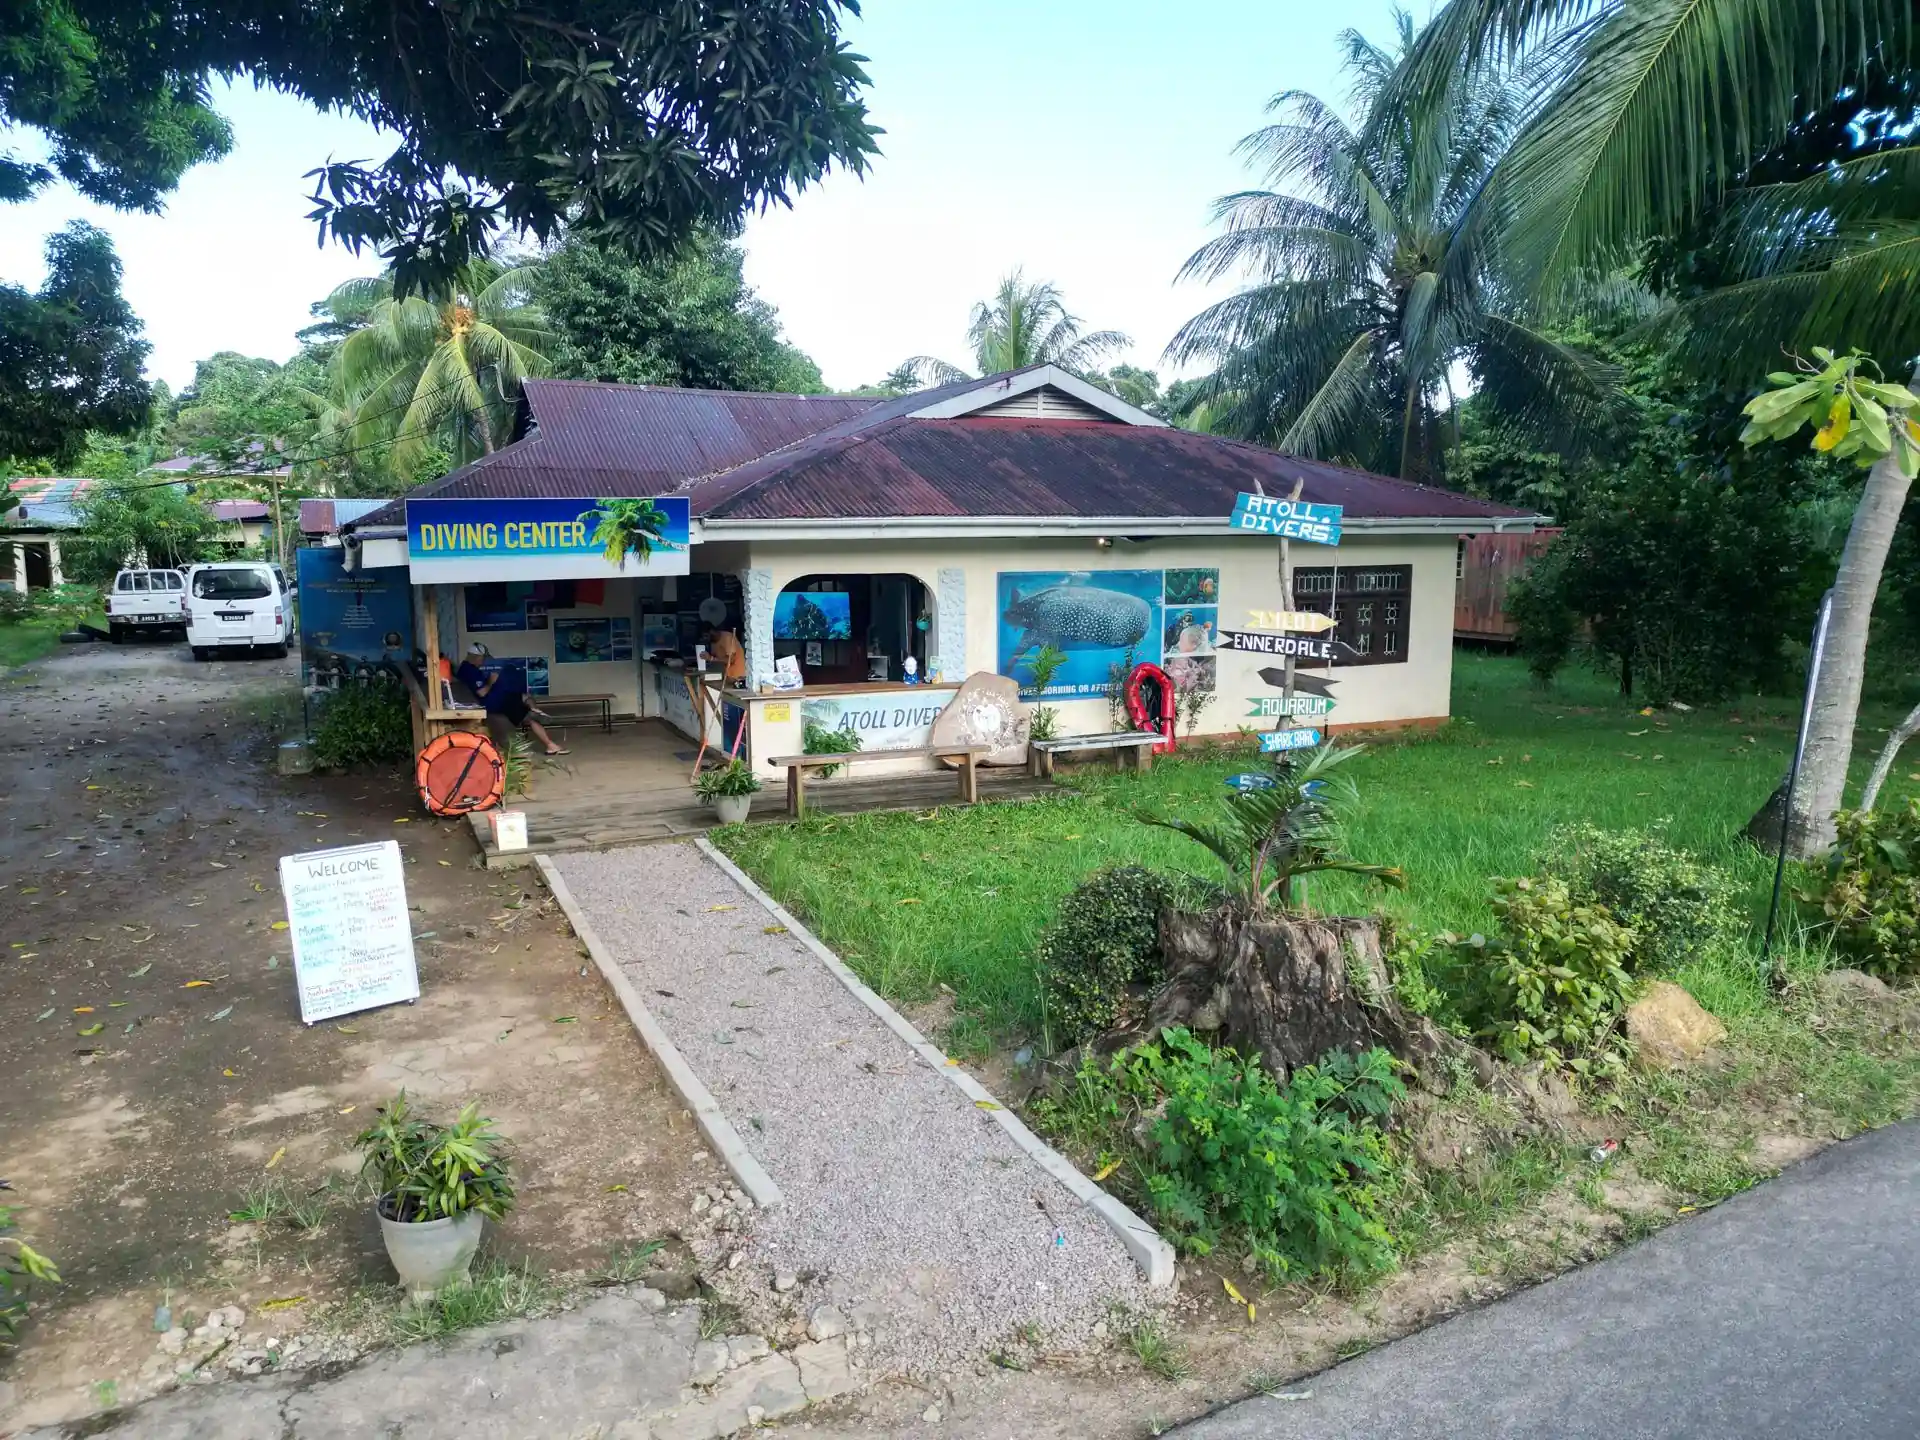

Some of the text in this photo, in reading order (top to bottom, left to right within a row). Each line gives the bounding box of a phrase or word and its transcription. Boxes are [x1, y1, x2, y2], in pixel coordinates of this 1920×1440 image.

[421, 521, 587, 550] DIVING CENTER
[1241, 513, 1329, 541] DIVERS
[1078, 684, 1089, 693] OR
[1261, 697, 1327, 715] AQUARIUM
[837, 709, 887, 730] ATOLL
[1265, 729, 1315, 750] SHARK BANK
[308, 857, 380, 878] WELCOME
